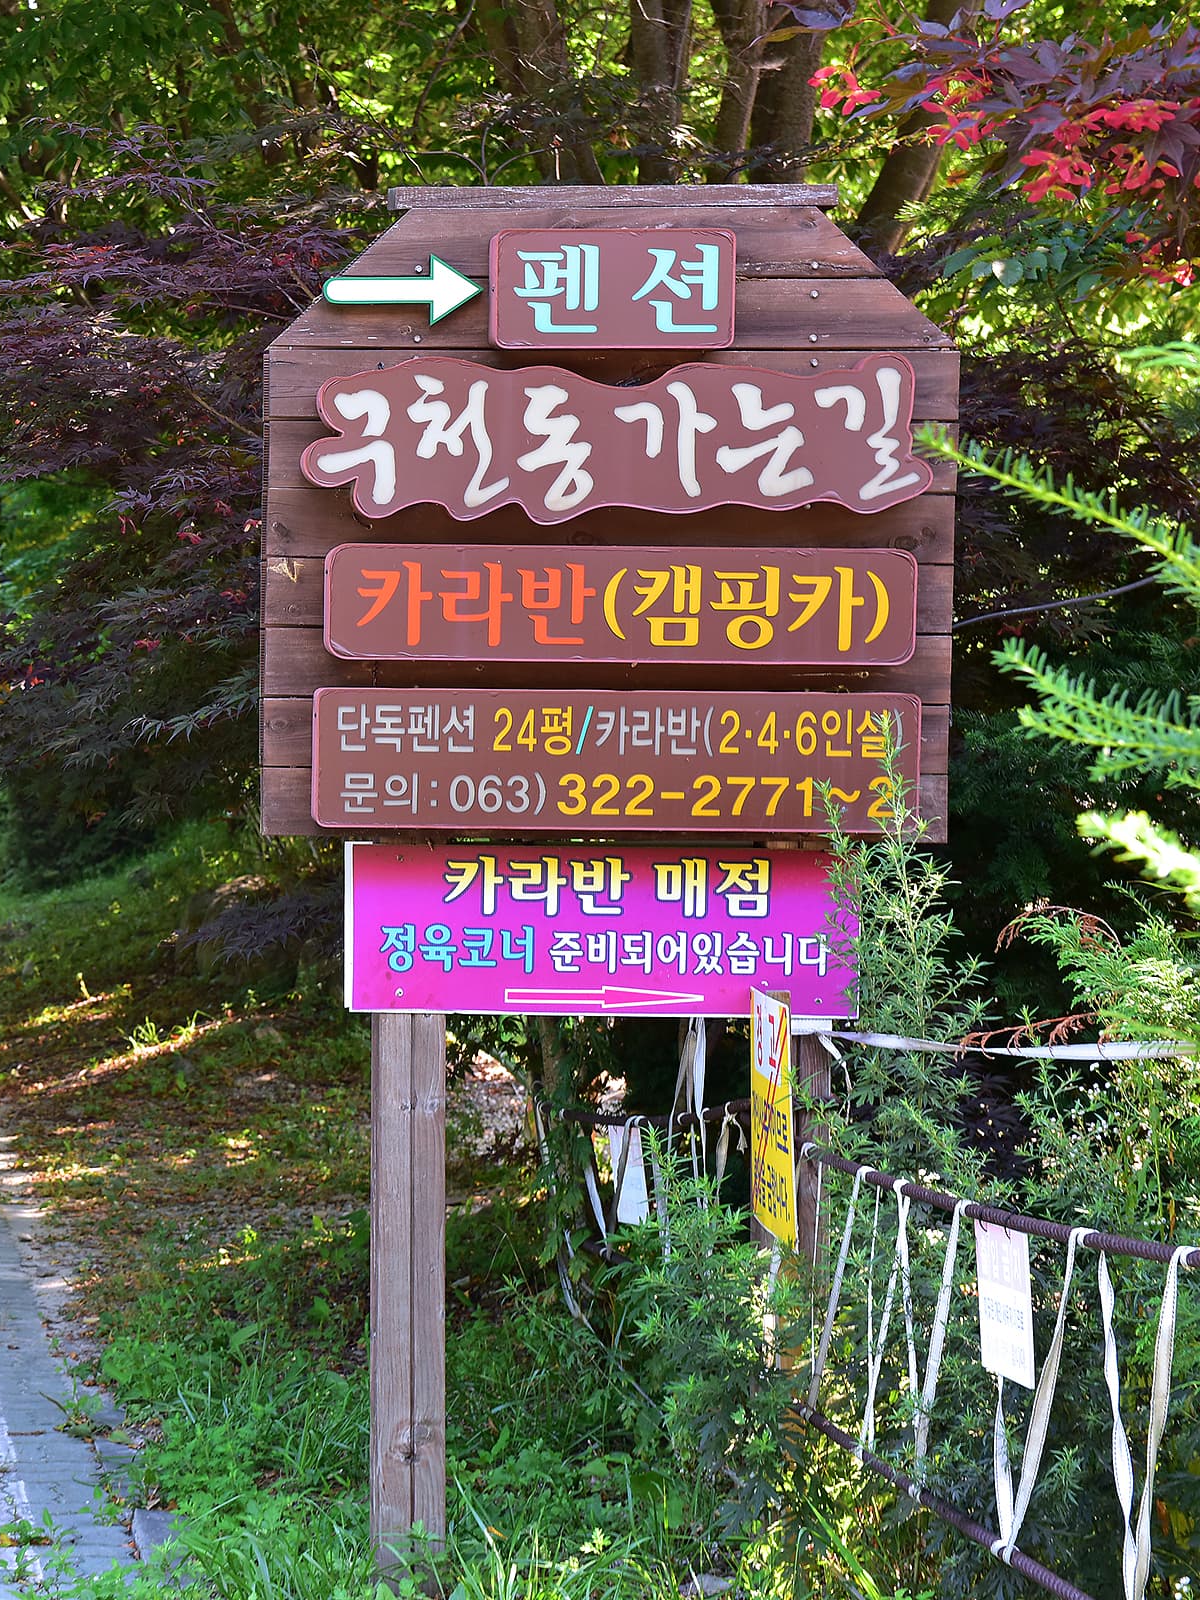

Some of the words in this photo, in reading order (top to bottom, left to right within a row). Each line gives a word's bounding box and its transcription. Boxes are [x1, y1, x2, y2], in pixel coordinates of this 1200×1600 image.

[317, 374, 596, 512] 구천동
[356, 561, 890, 653] 카라반(캠핑카)
[336, 703, 476, 753] 단독펜션
[443, 854, 631, 918] 카라반
[653, 856, 771, 918] 매점
[379, 923, 535, 974] 정육코너
[547, 929, 829, 977] 준비되어있습니다
